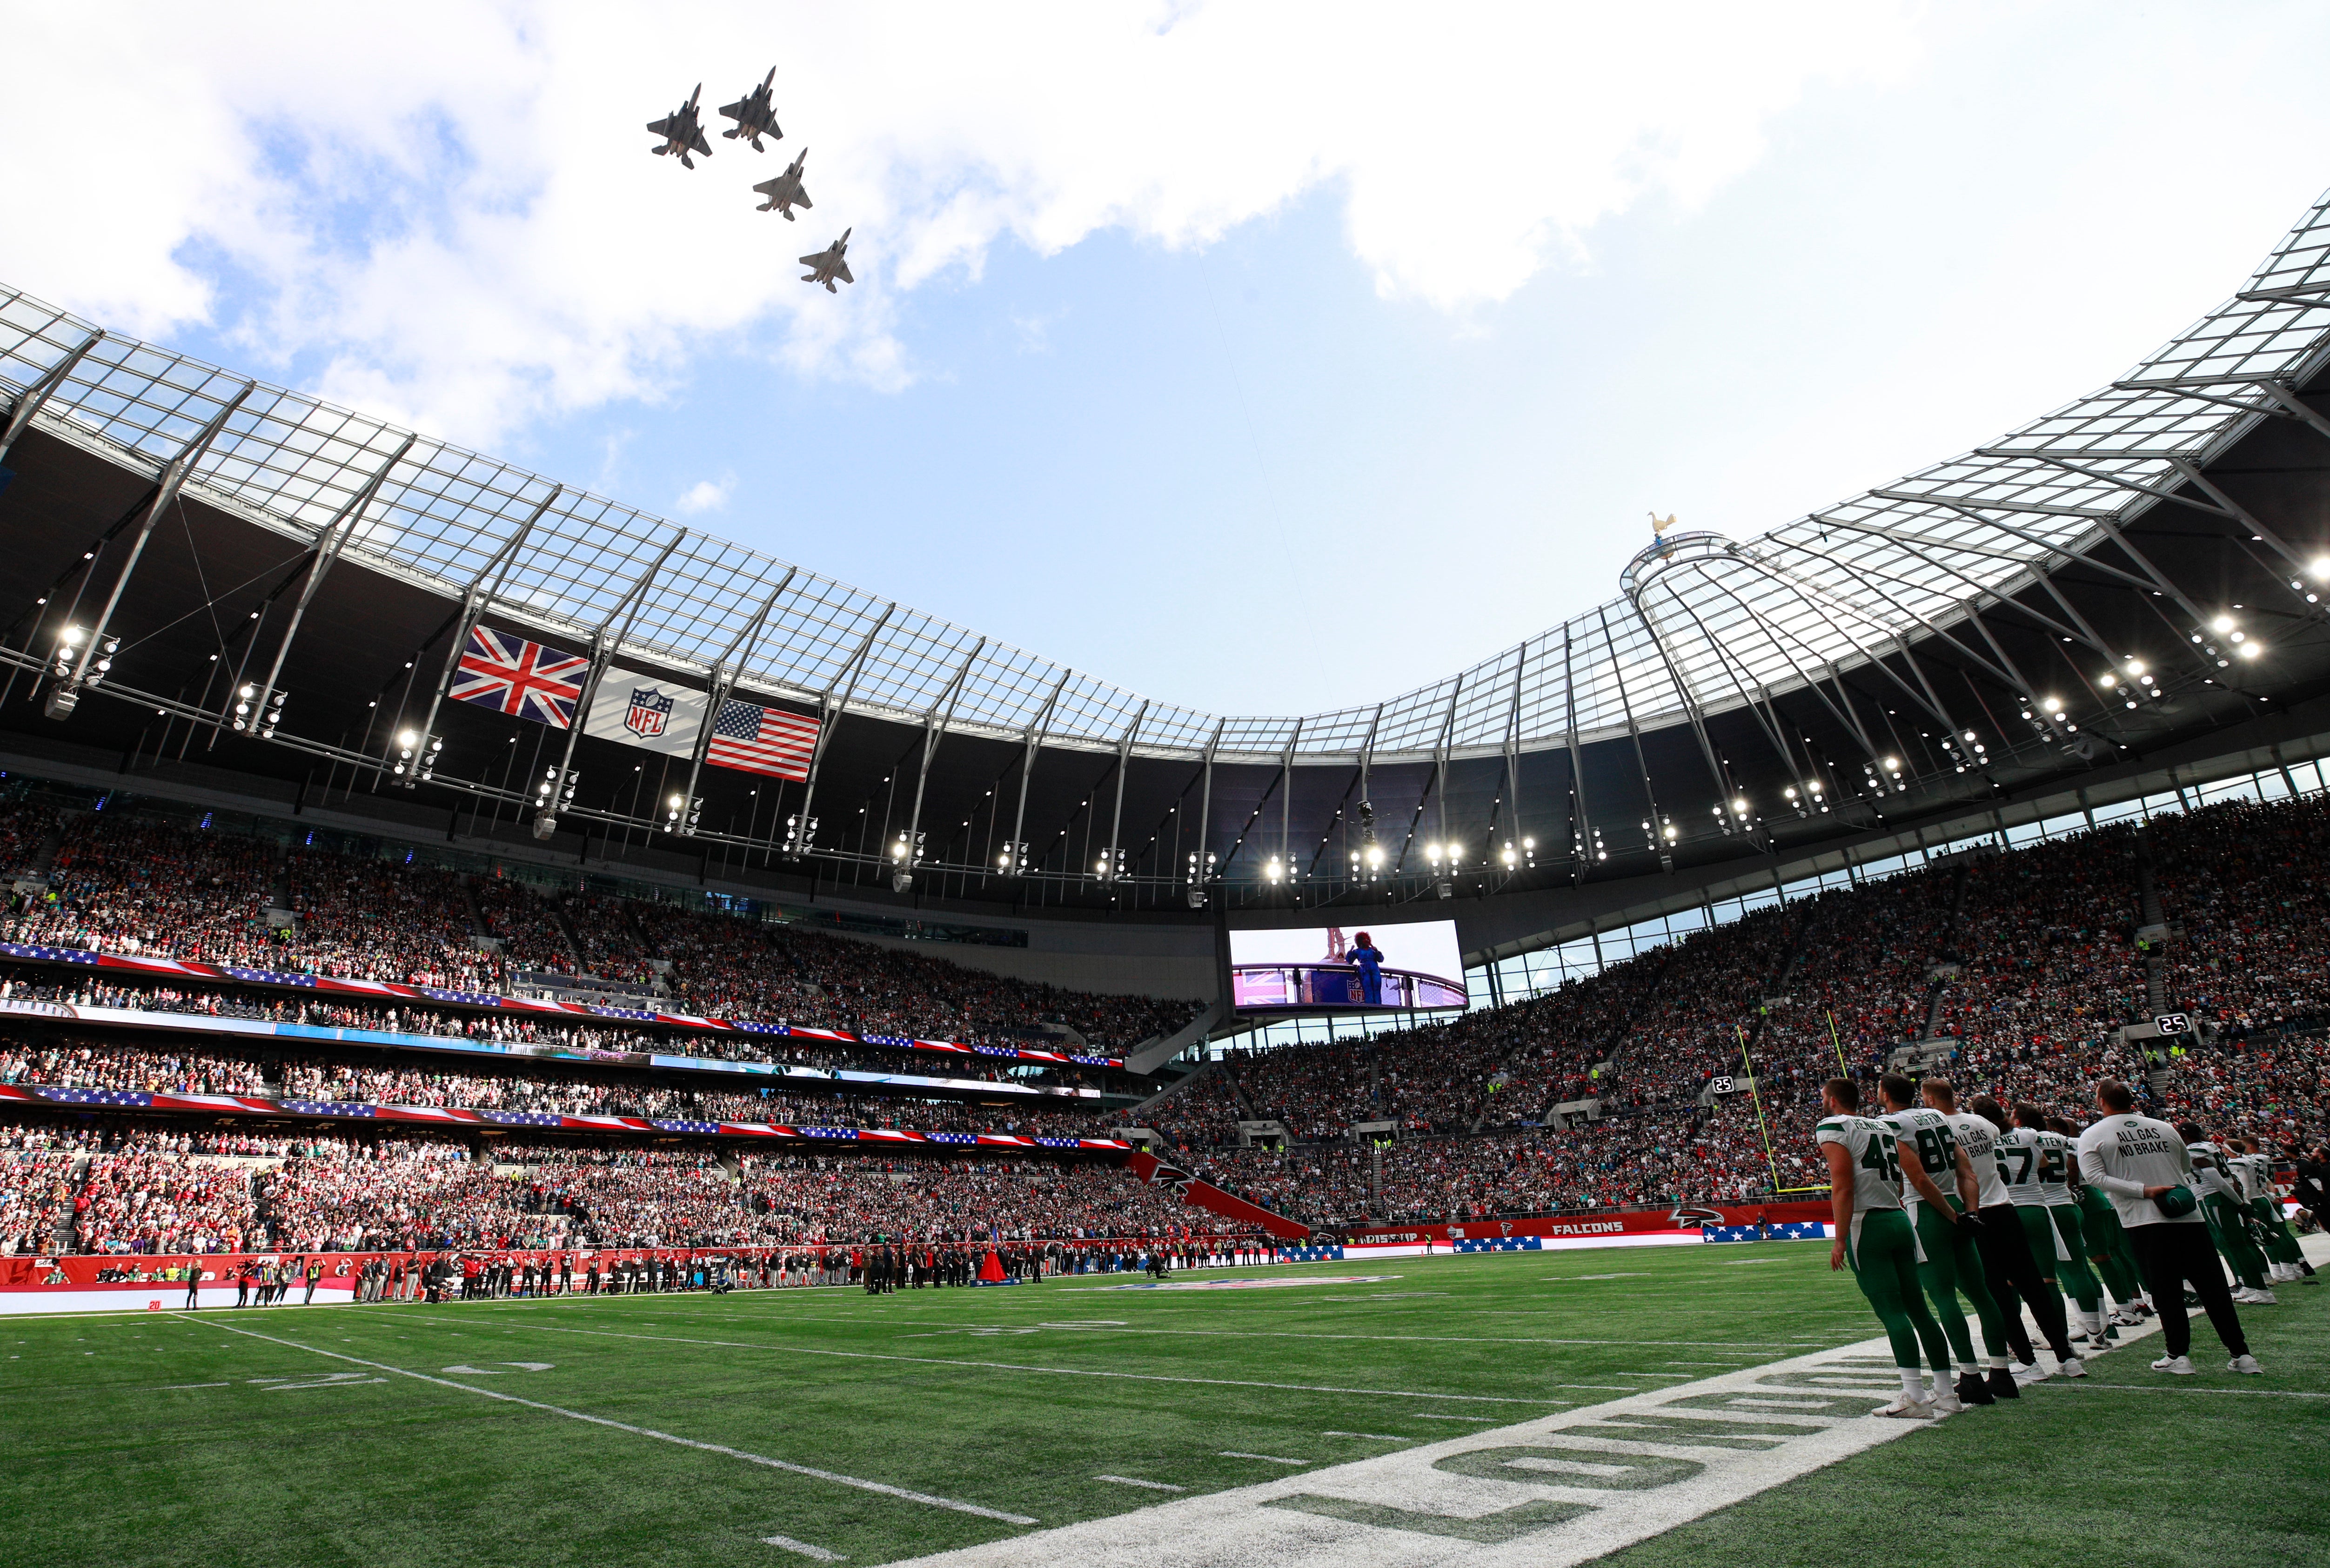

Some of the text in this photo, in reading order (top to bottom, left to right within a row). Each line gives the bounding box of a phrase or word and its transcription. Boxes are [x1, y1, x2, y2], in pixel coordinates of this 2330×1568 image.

[628, 706, 662, 734] NFL
[2161, 1016, 2186, 1032] 25
[1715, 1079, 1731, 1091] 25
[1912, 1112, 1943, 1126] GRIFFIN
[1970, 1129, 1988, 1143] GAS
[2116, 1127, 2161, 1143] ALL GAS
[1861, 1133, 1901, 1182] 42
[1915, 1125, 1956, 1174] 86
[1968, 1141, 1993, 1158] BRAKE
[2118, 1141, 2170, 1158] NO BRAKE
[1552, 1221, 1624, 1235] FALCONS
